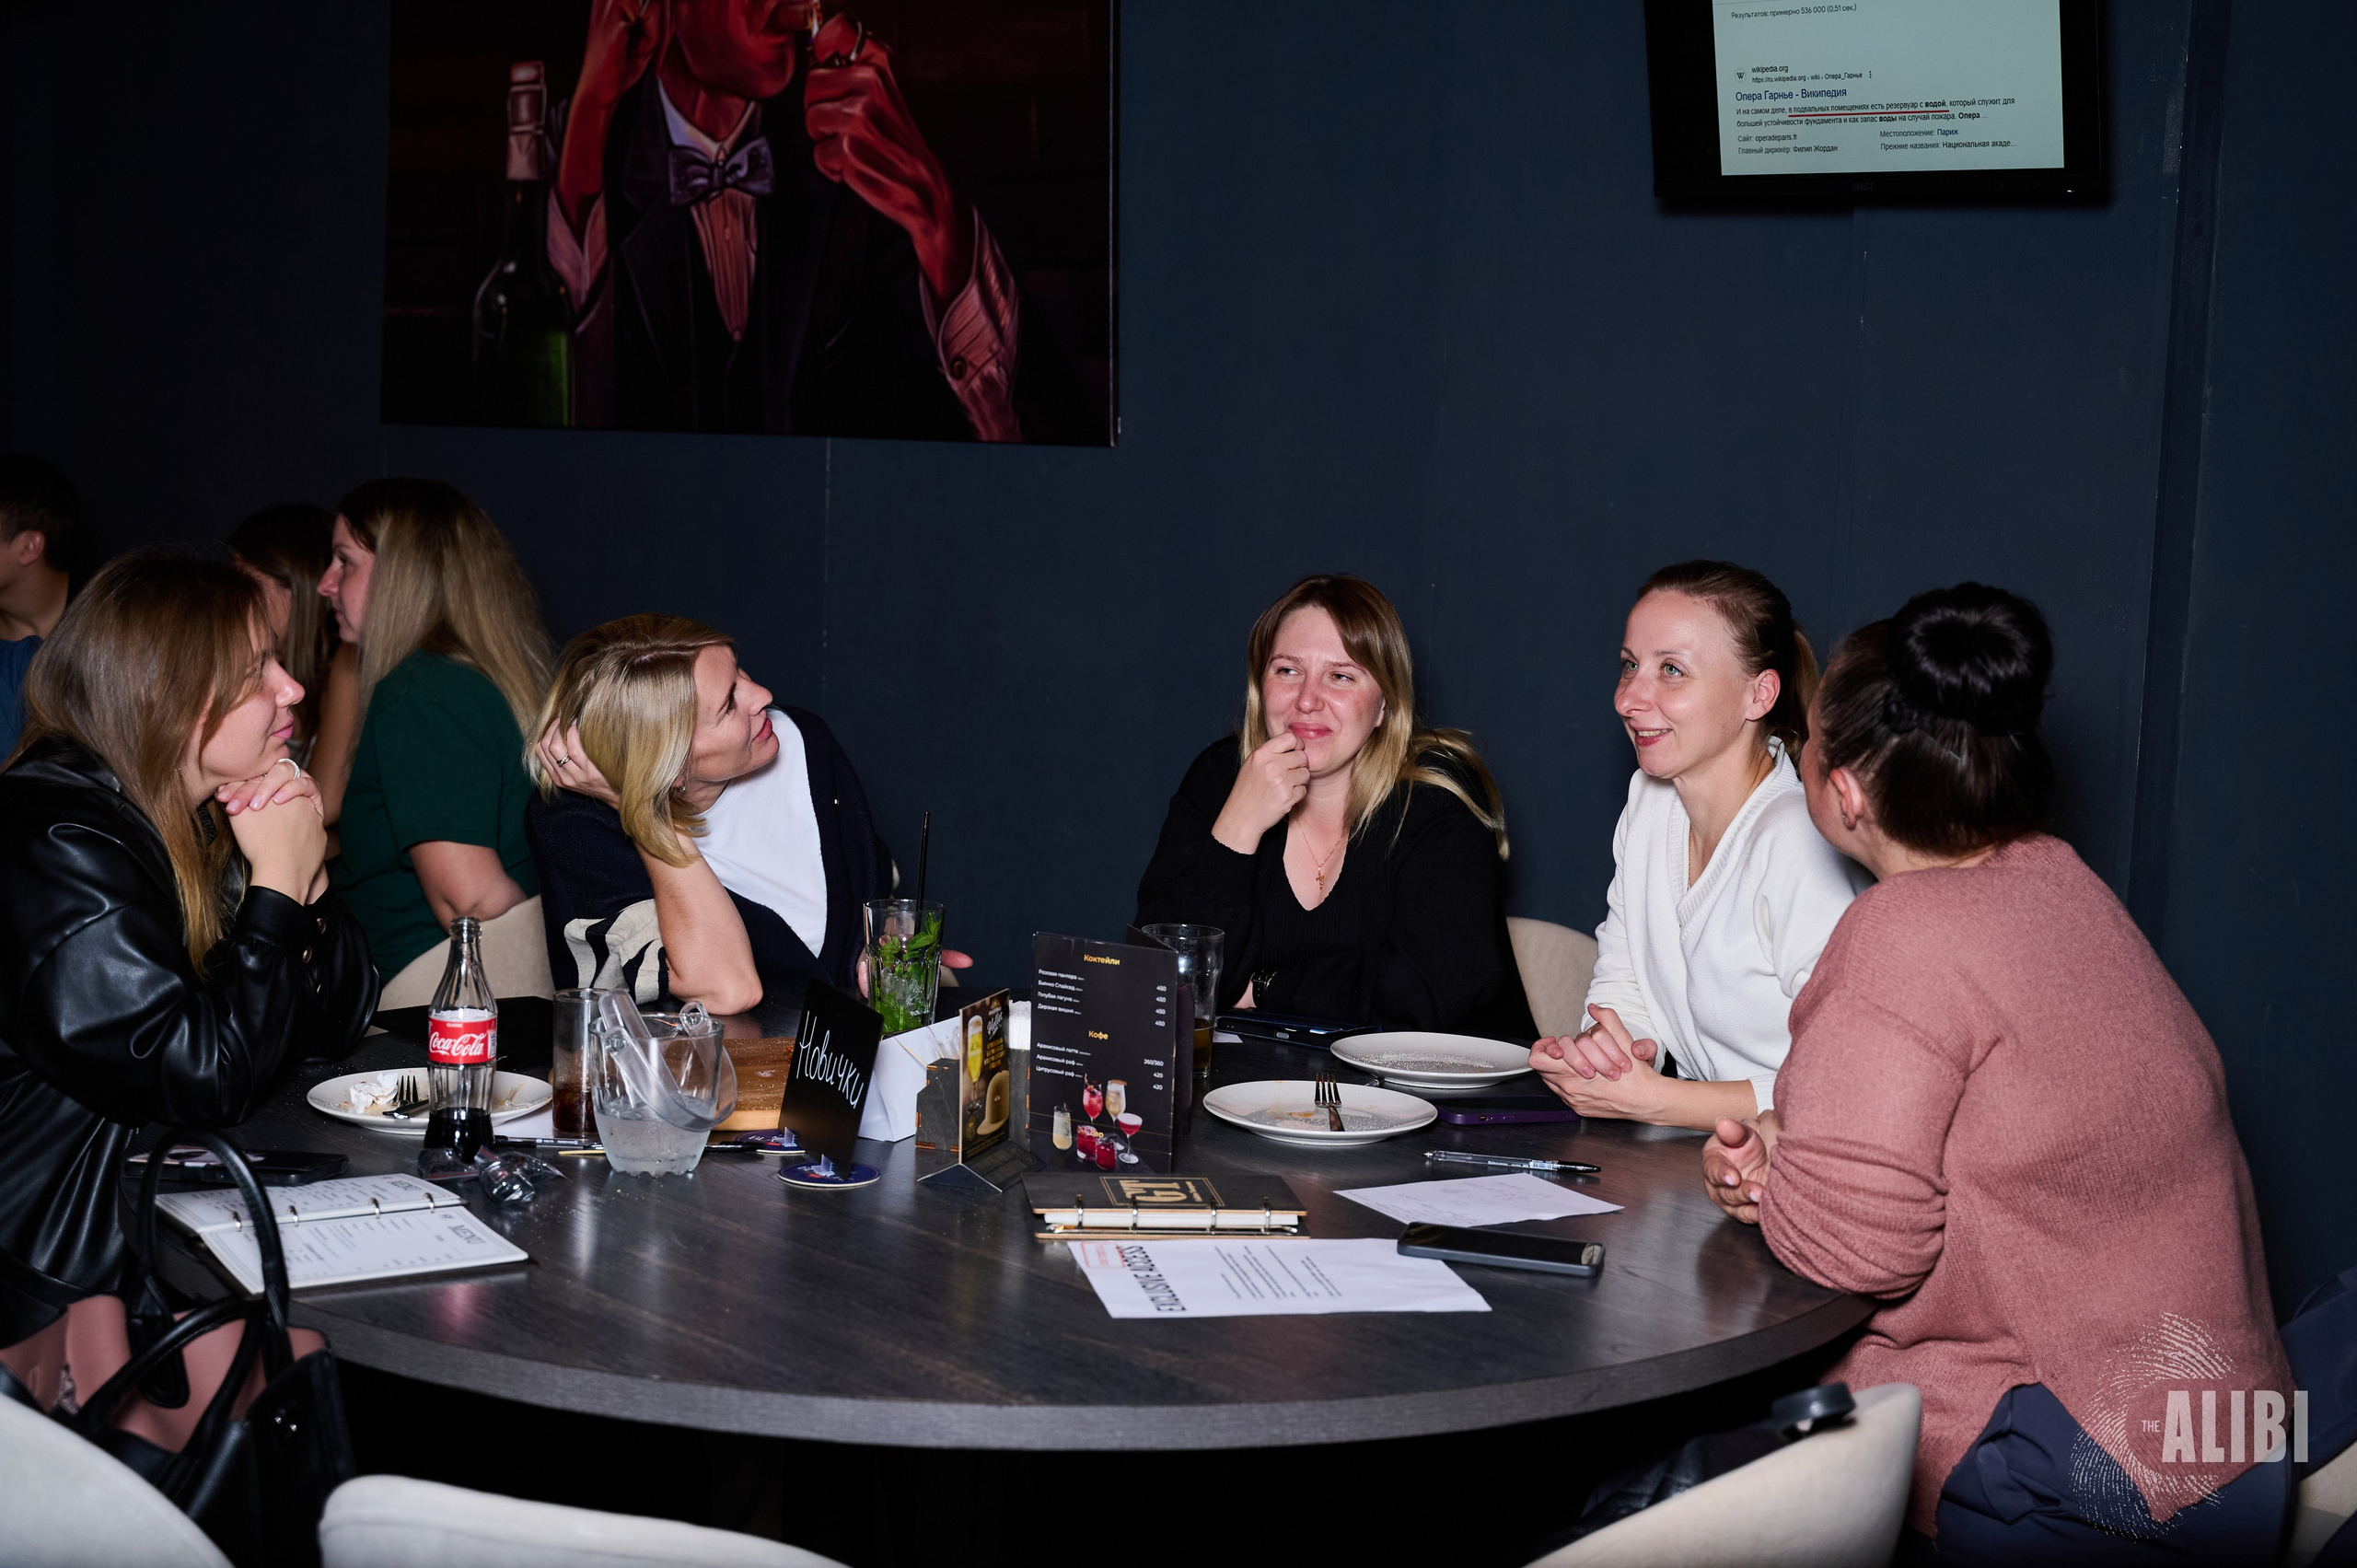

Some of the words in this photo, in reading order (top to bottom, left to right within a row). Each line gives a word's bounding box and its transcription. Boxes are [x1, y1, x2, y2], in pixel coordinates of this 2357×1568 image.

[1731, 11, 1769, 19] Результатов:
[1770, 8, 1800, 17] примерно
[1751, 64, 1789, 74] wikipedia.org
[1751, 74, 1806, 84] https://ru.wikipedia.org
[1824, 72, 1864, 81] Опера_Гарнье
[1736, 91, 1762, 102] Опера
[1764, 89, 1794, 101] Гарнье
[1801, 87, 1847, 99] Википедия
[1794, 105, 1829, 113] подвальных
[1830, 103, 1869, 112] помещениях
[1886, 100, 1919, 110] резервуар
[1924, 99, 1948, 108] водой,
[1949, 99, 1976, 107] который
[2002, 98, 2015, 106] для
[1736, 120, 1762, 128] большей
[1764, 119, 1803, 128] устойчивости
[1805, 116, 1841, 126] фундамента
[1860, 115, 1877, 123] запас
[1878, 114, 1897, 123] воды
[1907, 112, 1930, 122] случай
[1931, 112, 1956, 121] пожара.
[1958, 110, 1980, 120] Опера
[1737, 134, 1754, 143] Сайт:
[1755, 134, 1798, 143] operadeparis.fr
[1879, 129, 1935, 138] Местоположение:
[1936, 127, 1959, 136] Париж
[1738, 145, 1764, 155] Главный
[1813, 144, 1839, 154] Жордан
[1880, 143, 1909, 151] Прежние
[1910, 142, 1941, 150] названия:
[1942, 140, 1990, 149] Национальная
[1084, 953, 1120, 966] Коктейли
[1088, 1030, 1109, 1040] Кофе
[429, 1031, 488, 1057] Coca-Cola
[795, 1009, 865, 1109] Новички
[447, 1225, 486, 1245] MENU
[1115, 1245, 1159, 1272] ACCESS
[1133, 1273, 1187, 1312] EXCLUSIVE
